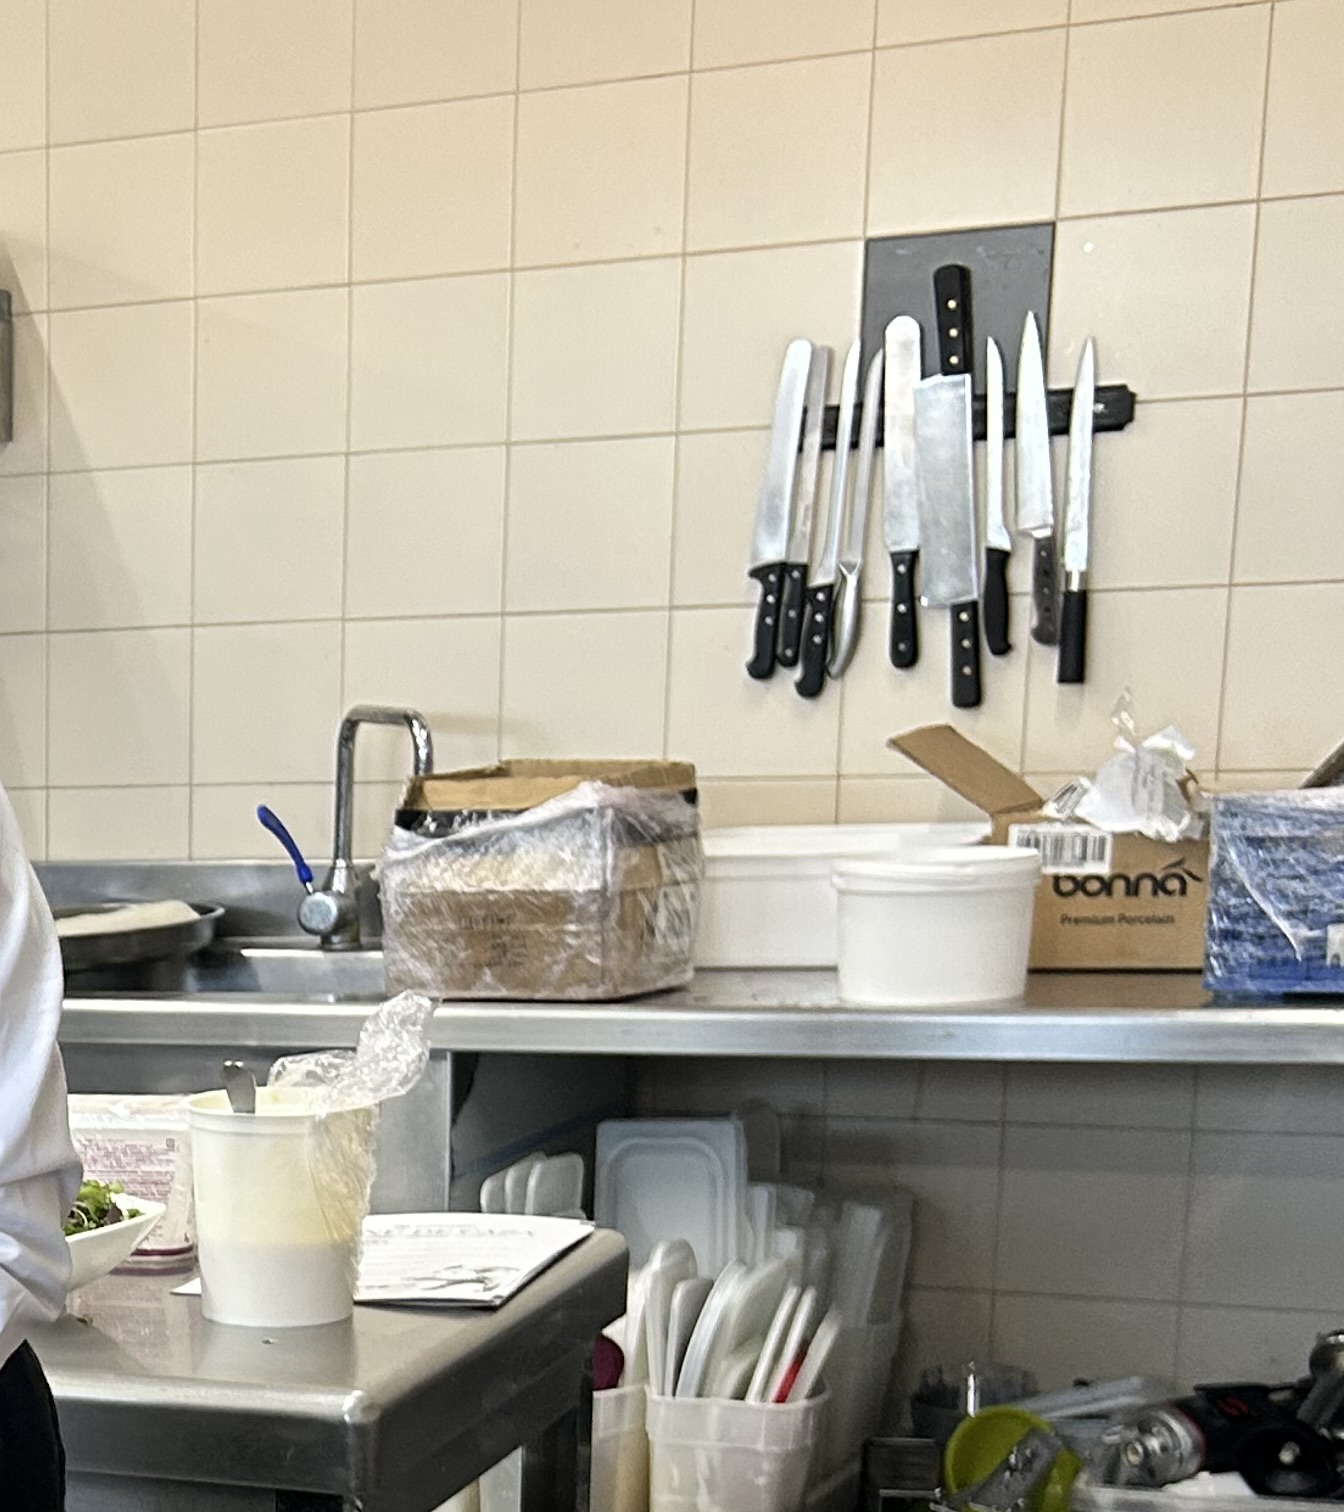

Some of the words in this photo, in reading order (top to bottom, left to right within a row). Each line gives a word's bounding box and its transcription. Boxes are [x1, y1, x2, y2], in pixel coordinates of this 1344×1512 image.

[1053, 872, 1188, 898] bonna
[1060, 912, 1116, 926] Premium
[1118, 911, 1175, 925] Porcelain
